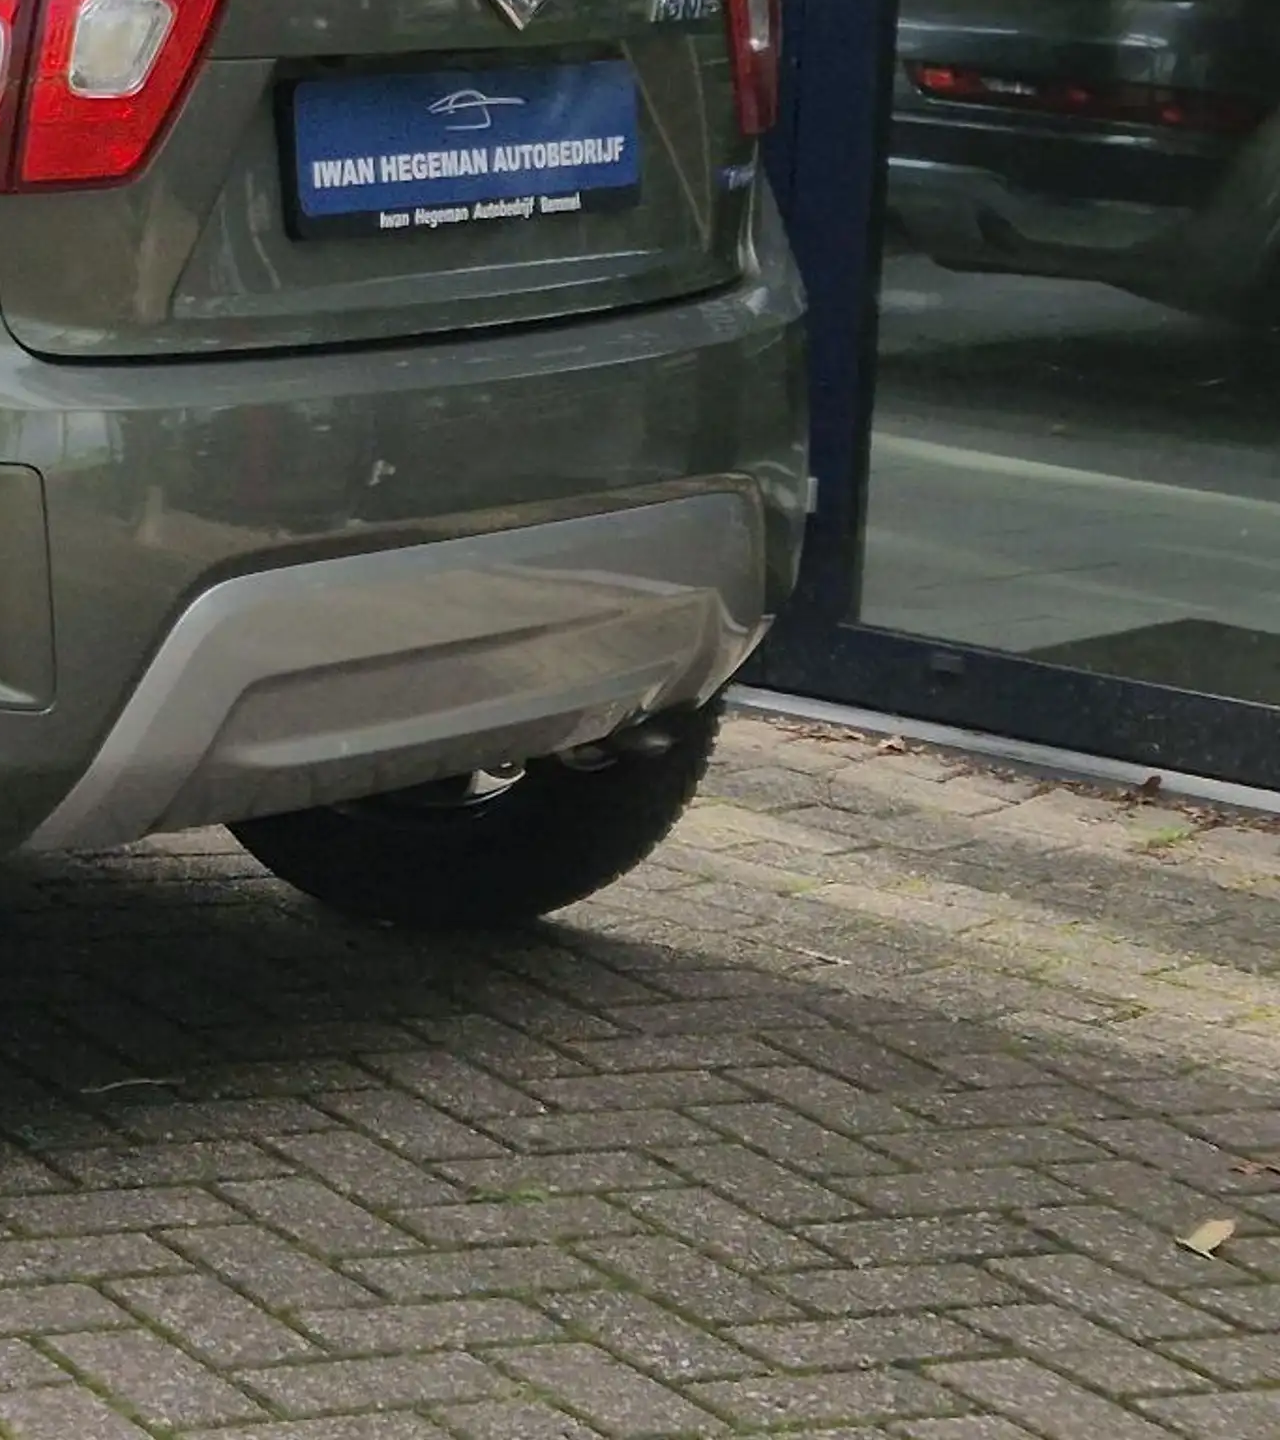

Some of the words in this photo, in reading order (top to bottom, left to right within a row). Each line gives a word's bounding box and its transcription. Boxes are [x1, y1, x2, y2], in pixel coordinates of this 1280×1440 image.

[313, 158, 375, 189] IWAN
[381, 147, 487, 182] HEGEMAN
[493, 136, 625, 172] AUTOBEDRIJF
[415, 207, 469, 228] Hegeman
